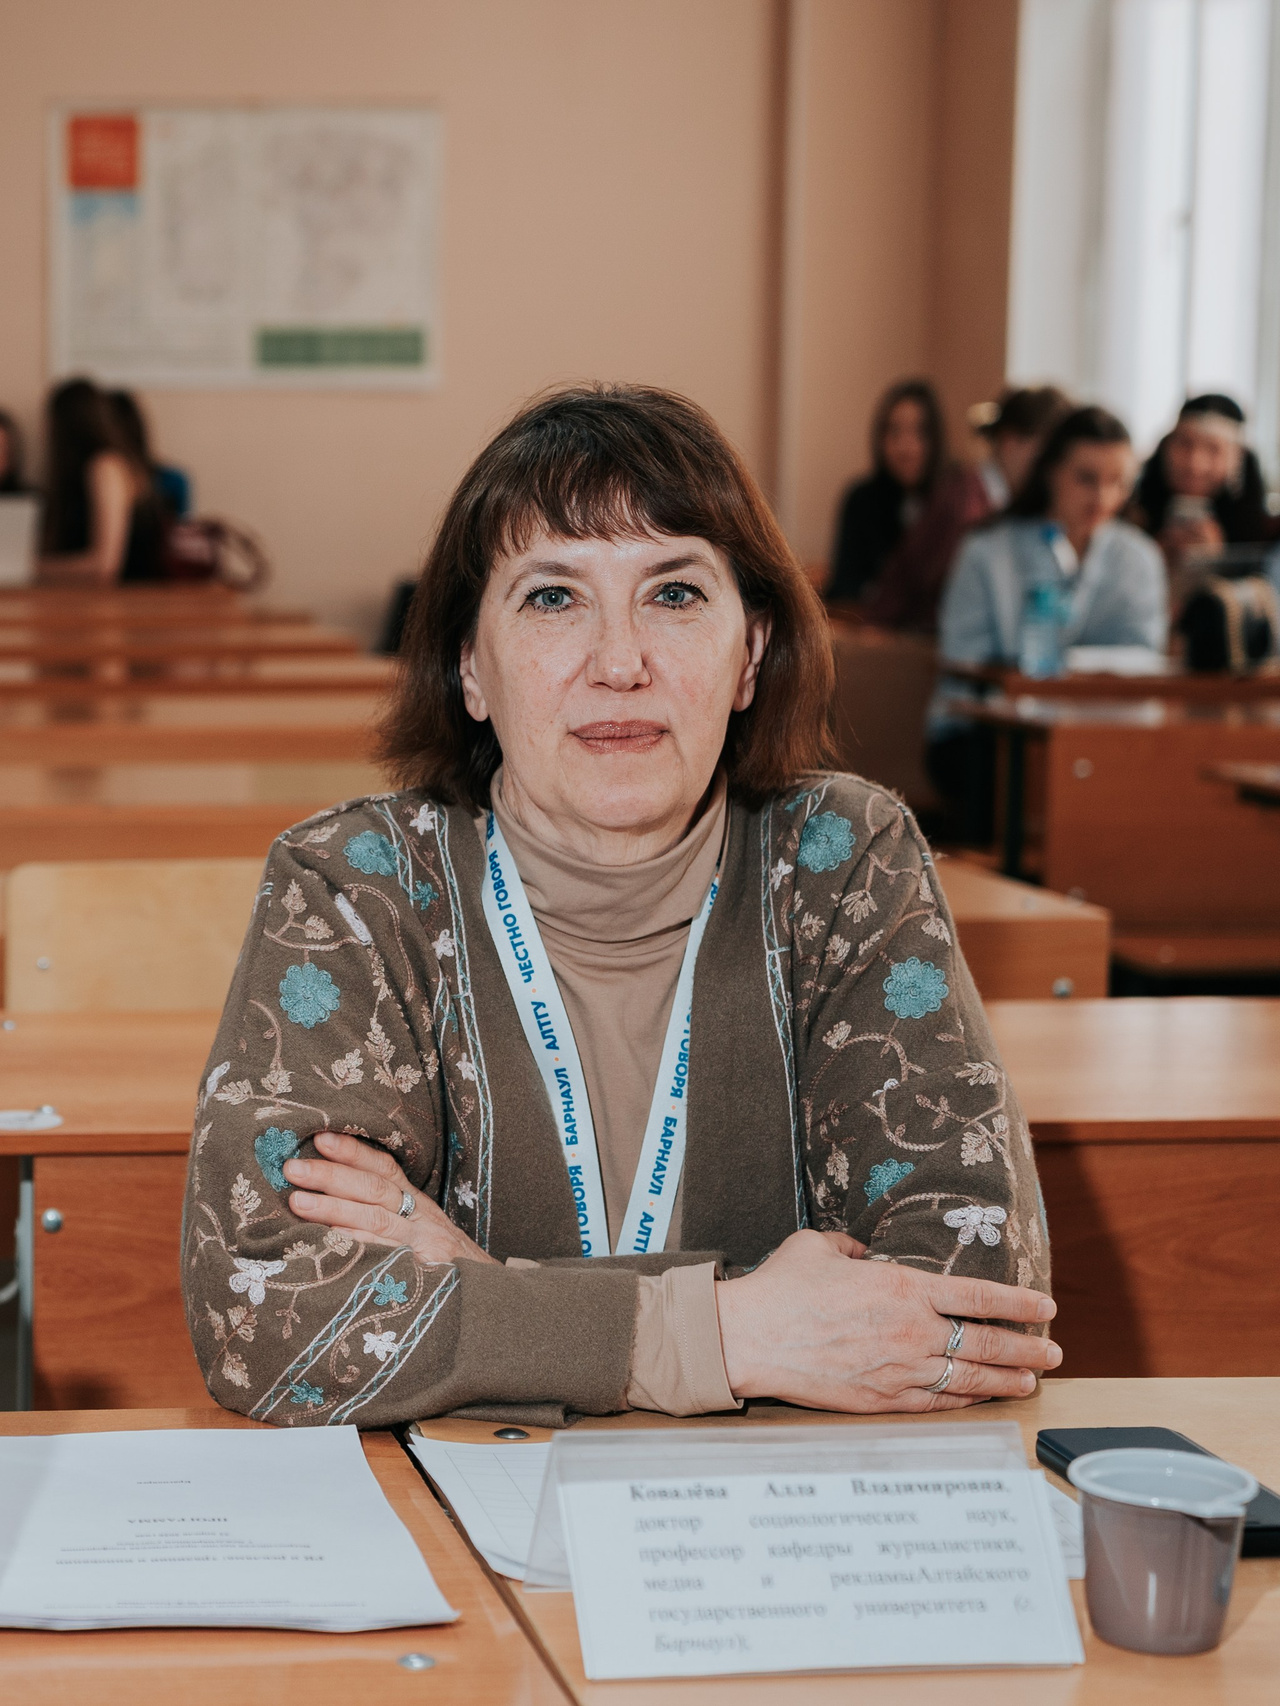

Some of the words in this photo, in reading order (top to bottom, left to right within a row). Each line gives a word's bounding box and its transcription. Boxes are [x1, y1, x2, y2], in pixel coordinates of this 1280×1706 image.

[488, 850, 512, 911] ГОВОРЯ
[502, 913, 535, 983] ЧЕСТНО
[531, 1001, 560, 1050] АЛТГУ
[554, 1067, 579, 1146] БАРНАУЛ
[648, 1116, 677, 1196] БАРНАУЛ
[629, 1482, 728, 1502] Ковалёва
[764, 1481, 817, 1498] Алла
[633, 1514, 704, 1534] доктор
[748, 1510, 919, 1530] социологических
[965, 1507, 1018, 1527] наук,
[639, 1541, 746, 1566] профессор
[767, 1538, 853, 1562] кафедры
[876, 1536, 1024, 1560] журналистики,
[644, 1575, 706, 1592] медиа
[760, 1573, 774, 1590] и
[648, 1601, 828, 1625] государственного
[853, 1596, 988, 1620] университета
